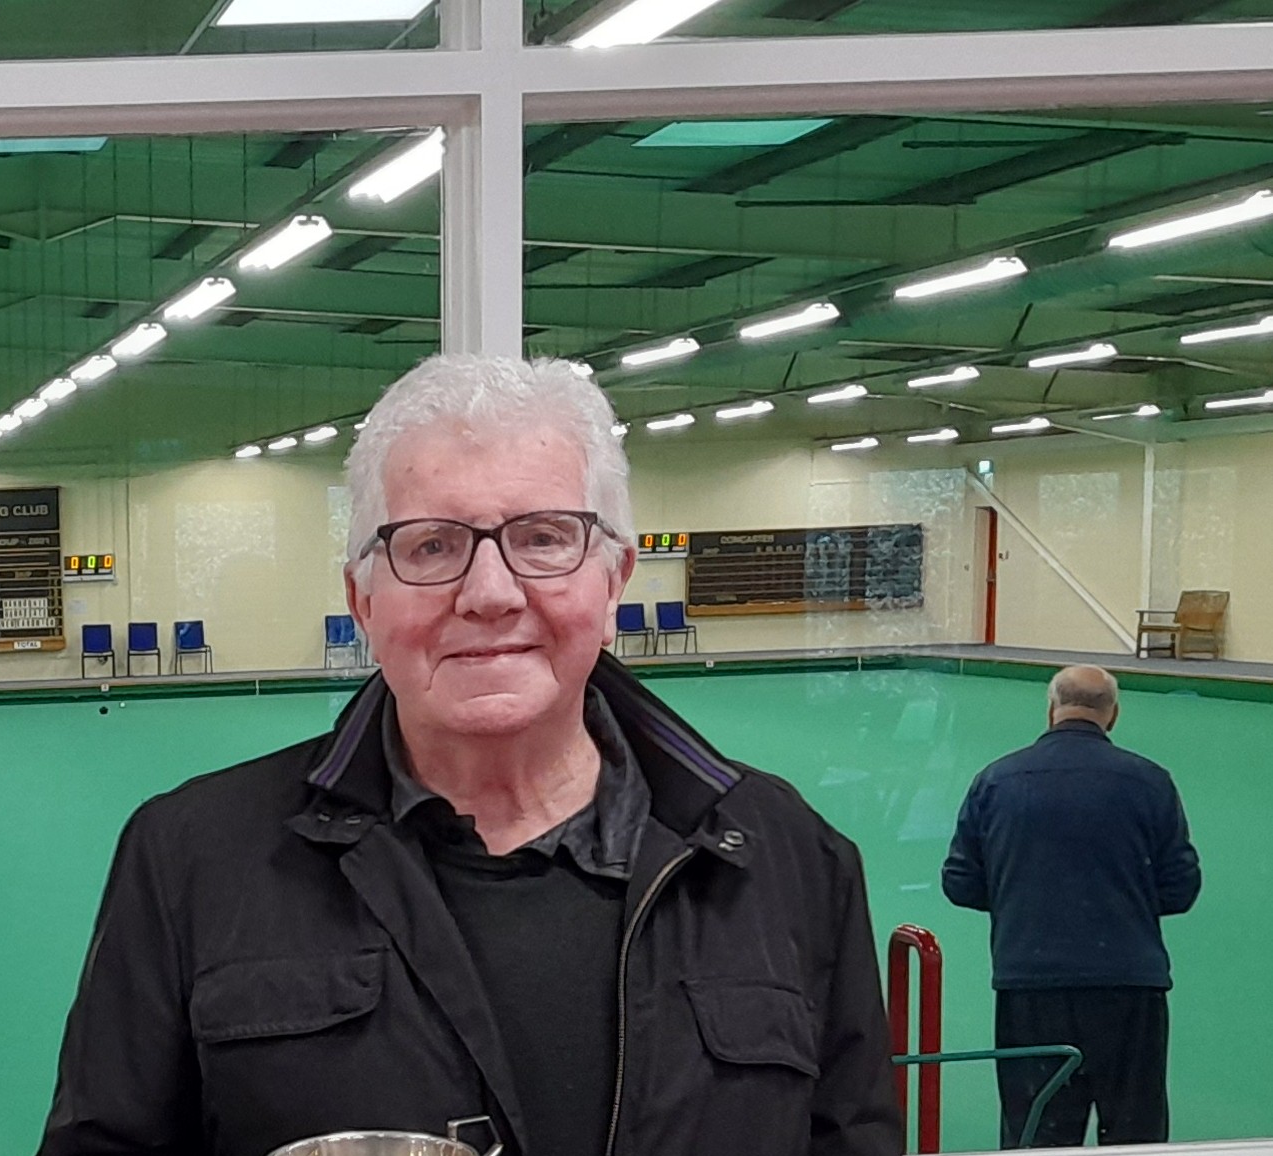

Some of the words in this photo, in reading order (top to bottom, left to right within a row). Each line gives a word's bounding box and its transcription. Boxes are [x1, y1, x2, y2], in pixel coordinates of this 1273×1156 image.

[13, 504, 48, 516] CLUB
[645, 534, 653, 547] 0
[662, 534, 670, 546] 0
[678, 533, 686, 545] 0
[71, 556, 78, 569] 0
[88, 555, 96, 568] 0
[104, 555, 112, 567] 0
